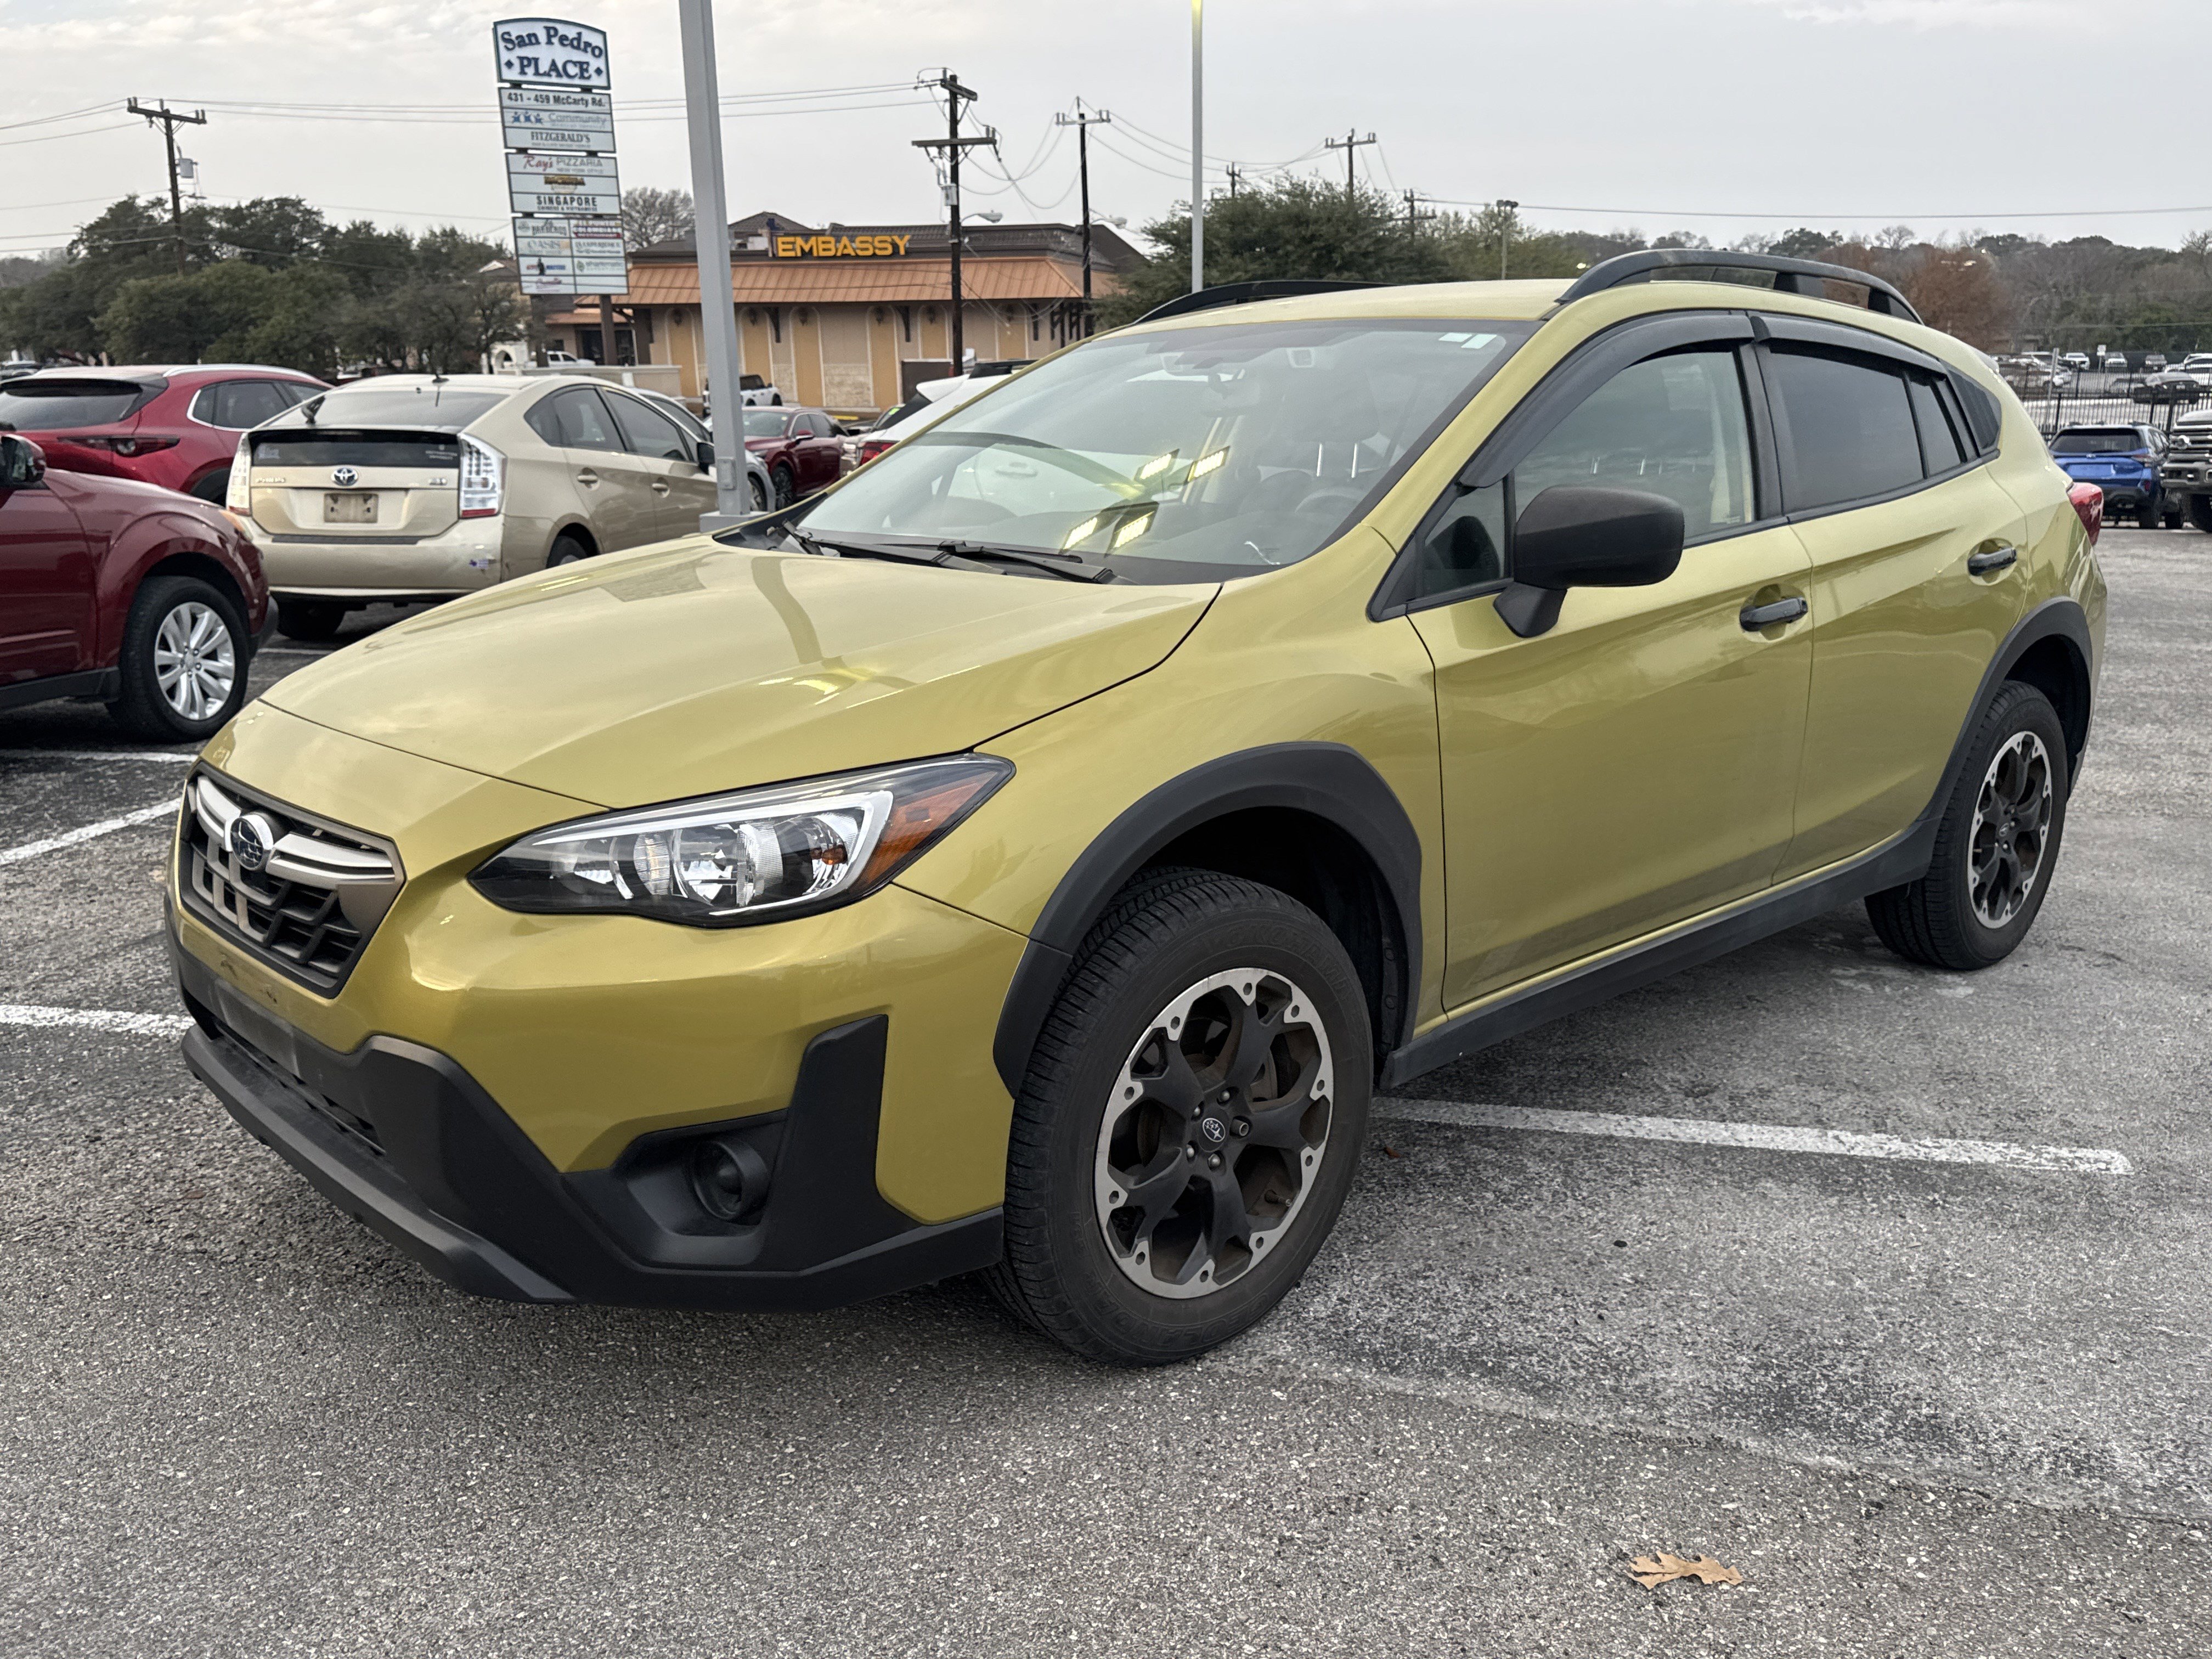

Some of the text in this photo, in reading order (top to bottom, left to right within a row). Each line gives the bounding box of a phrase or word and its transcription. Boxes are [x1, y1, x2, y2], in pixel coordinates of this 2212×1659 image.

[500, 26, 603, 58] San Pedro
[516, 56, 592, 80] PLACE
[507, 92, 523, 102] 431
[533, 94, 550, 104] 459
[552, 95, 589, 108] McCarty
[591, 97, 605, 107] Rd.
[531, 131, 591, 143] FITZGERALD'S
[536, 196, 597, 206] SINGAPORE
[777, 235, 911, 257] EMBASSY
